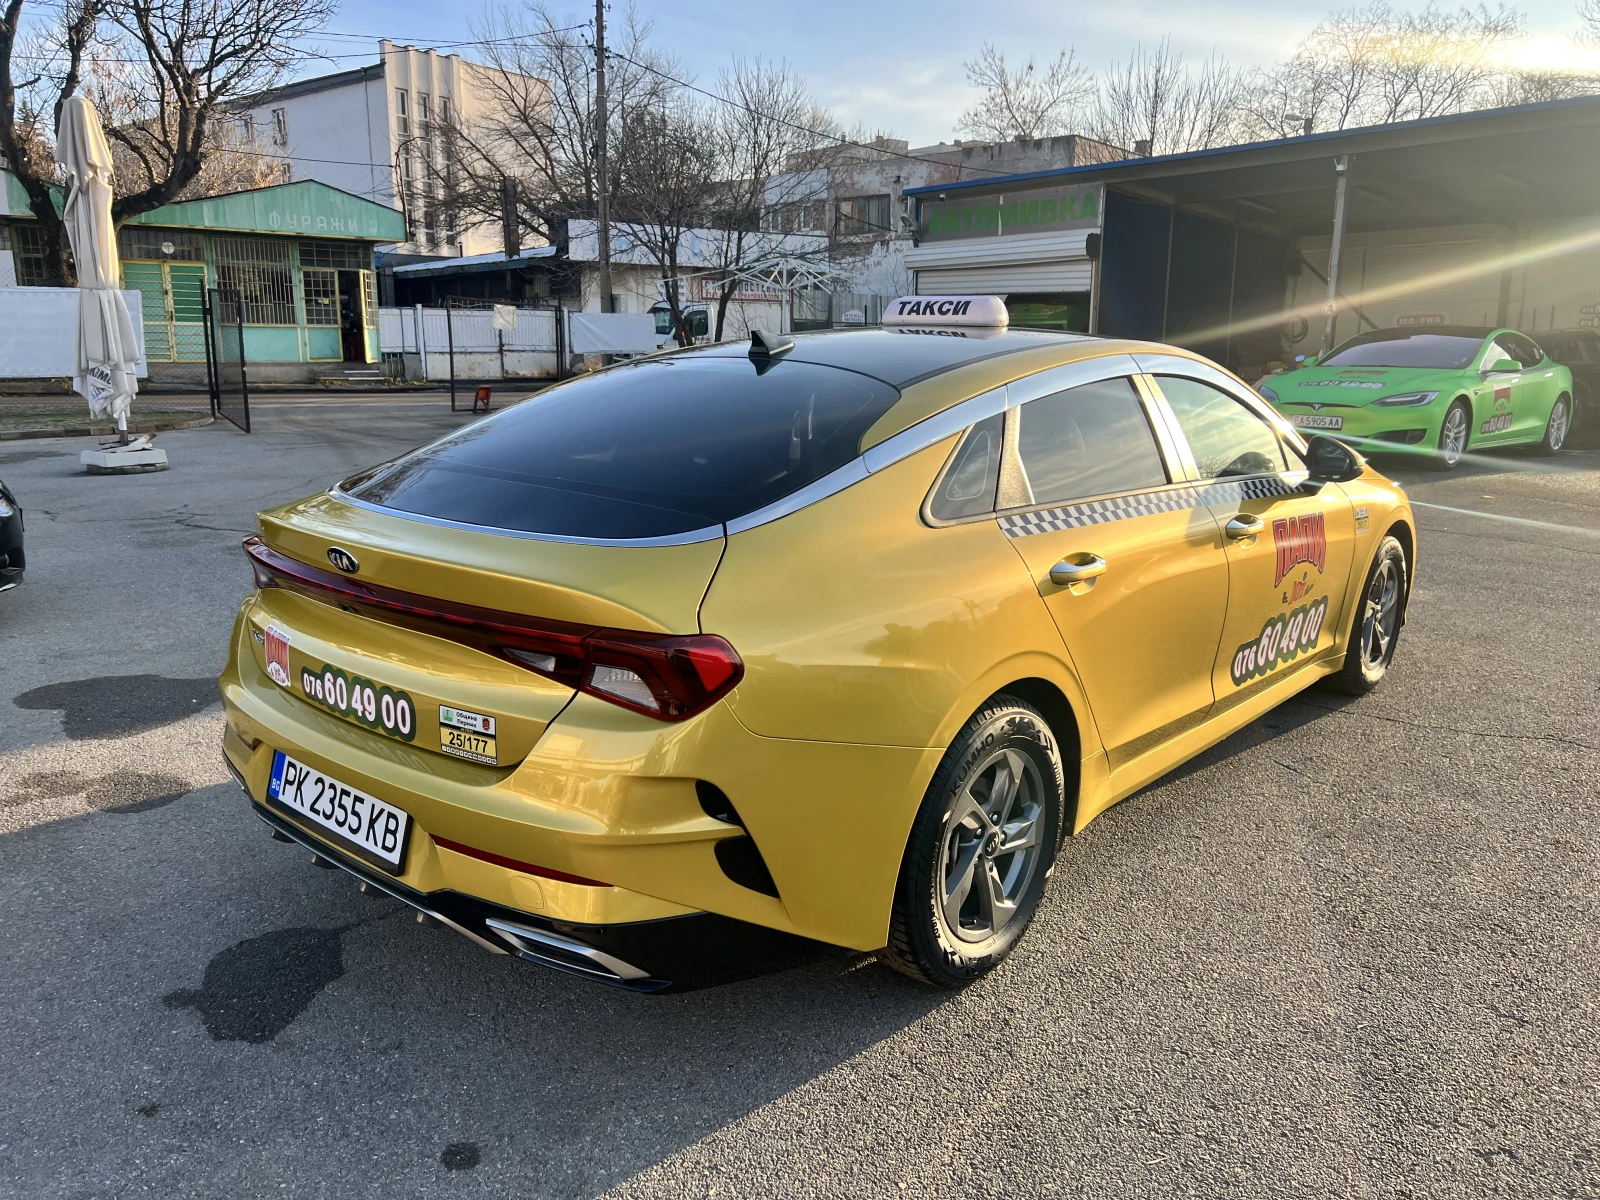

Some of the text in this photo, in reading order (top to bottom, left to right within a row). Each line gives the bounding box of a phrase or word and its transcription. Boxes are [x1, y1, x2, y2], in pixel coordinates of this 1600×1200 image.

[269, 210, 359, 232] ФУРАЖИ
[928, 193, 1098, 235] АВТОМИВКА
[898, 301, 972, 315] ТАКСИ
[1306, 417, 1327, 426] 5905
[1328, 418, 1340, 427] AA
[329, 551, 353, 571] KIA
[1273, 512, 1326, 588] ПАПИ
[1234, 603, 1325, 679] 076 60 49 00
[303, 672, 323, 700] 076
[324, 672, 348, 711] 60
[351, 684, 376, 722] 49
[381, 694, 411, 735] 00
[448, 731, 488, 753] 25/177
[949, 732, 995, 797] KUMHO
[271, 778, 280, 791] BG
[282, 760, 400, 853] PK 2355 KB
